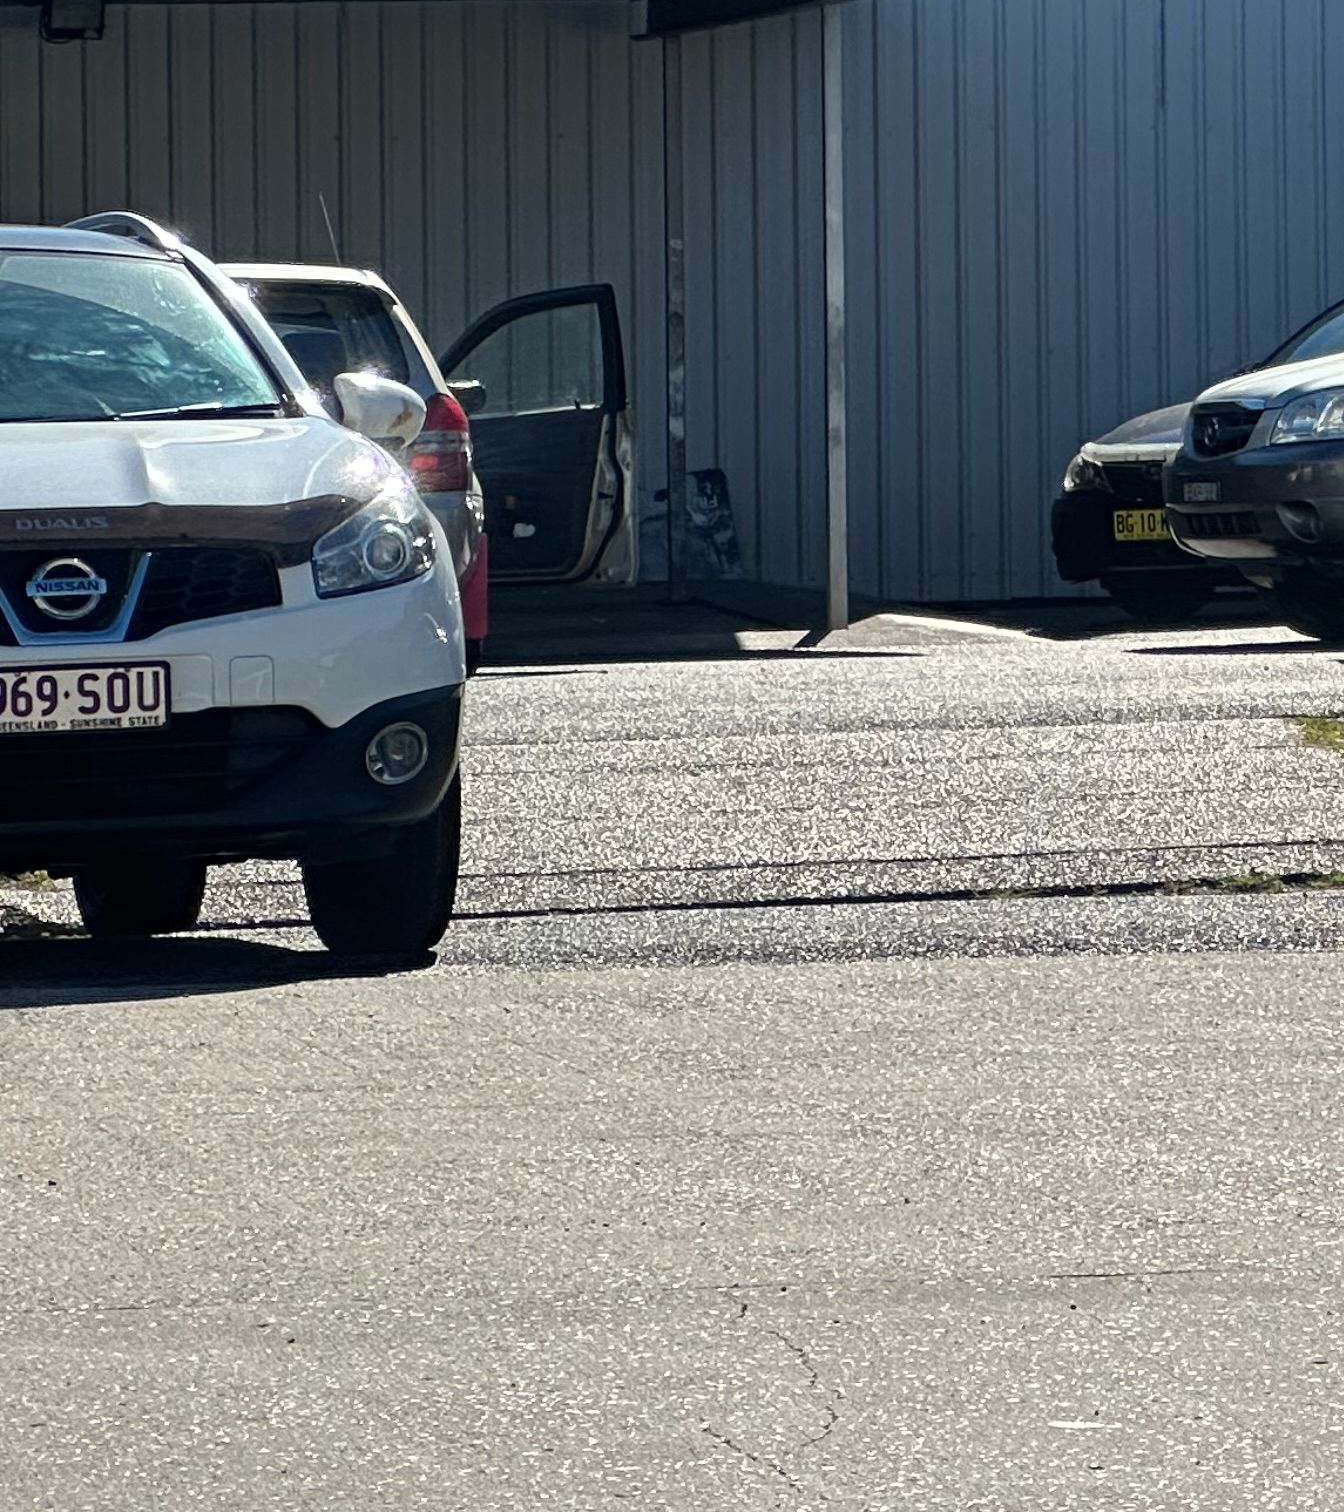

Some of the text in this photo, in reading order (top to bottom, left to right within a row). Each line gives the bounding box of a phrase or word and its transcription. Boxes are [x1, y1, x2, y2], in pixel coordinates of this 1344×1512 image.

[15, 517, 109, 530] DUALIS
[34, 580, 100, 593] NISSAN
[128, 715, 160, 727] STATE
